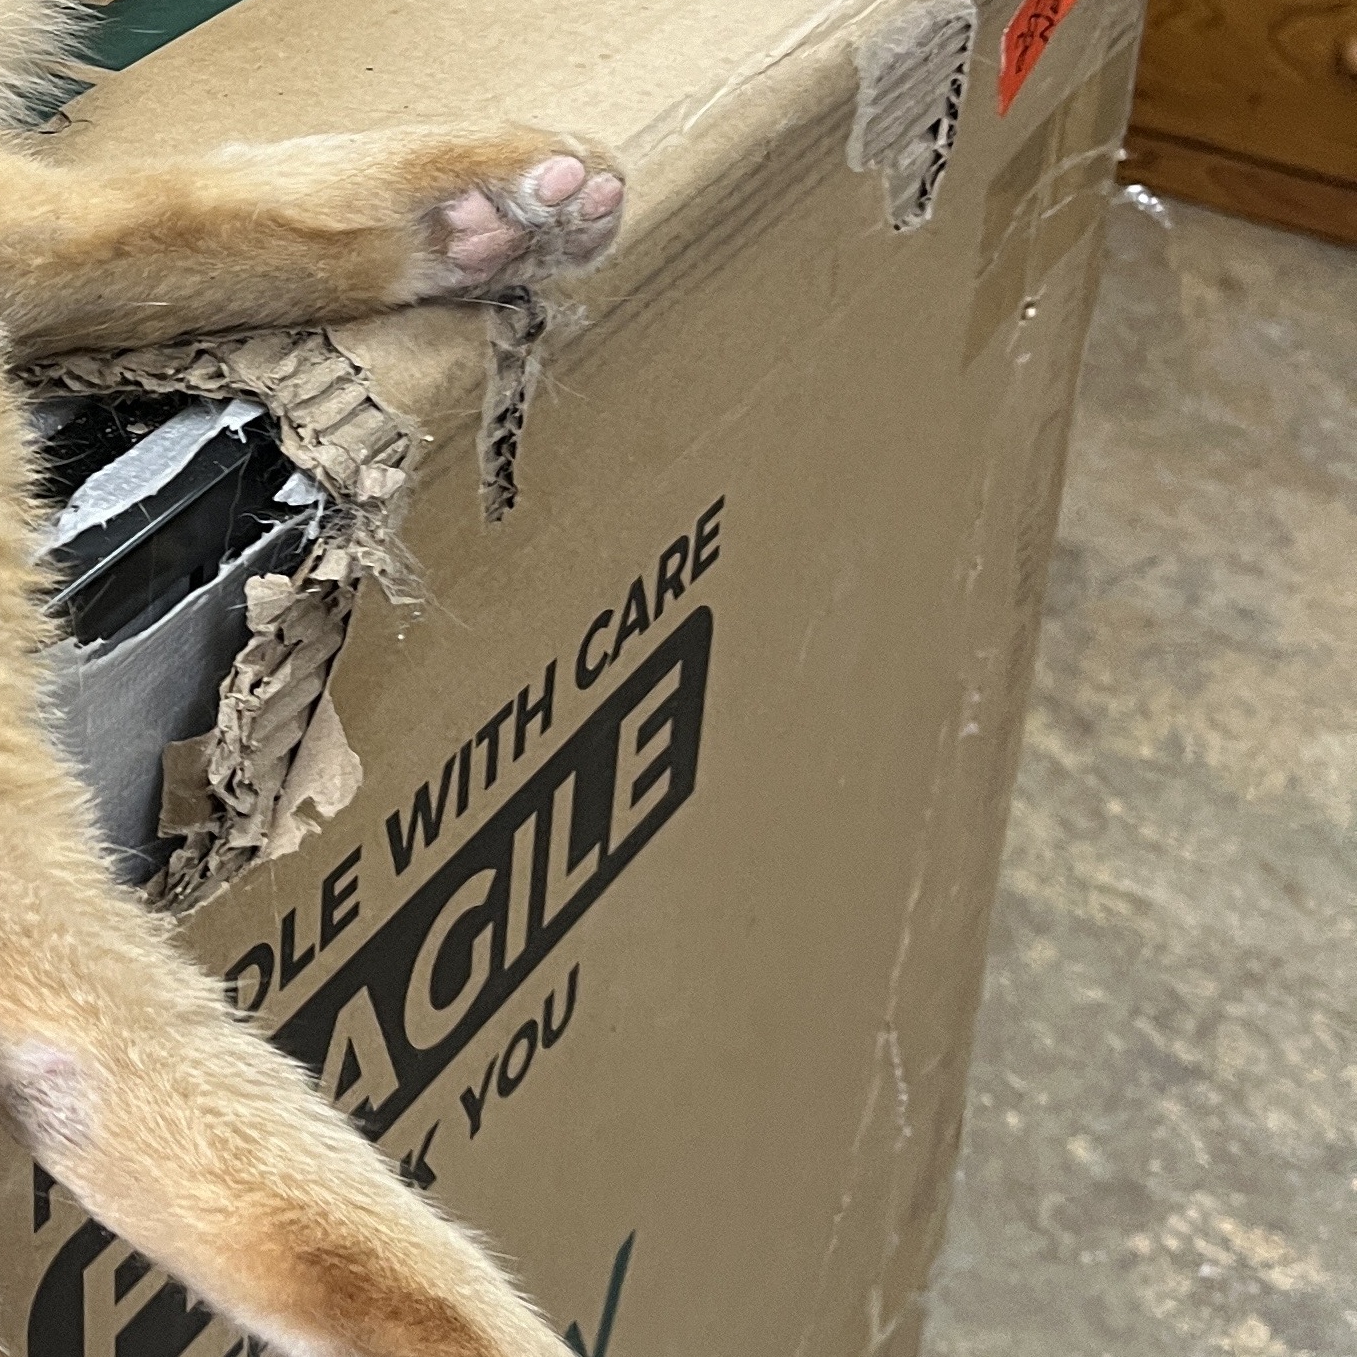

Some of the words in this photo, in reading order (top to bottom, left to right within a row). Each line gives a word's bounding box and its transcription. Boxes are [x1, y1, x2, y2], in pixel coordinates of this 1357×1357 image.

[224, 843, 364, 1020] DLE
[385, 656, 559, 878] WITH
[574, 493, 727, 691] CARE
[319, 658, 684, 1116] AGILE
[459, 961, 580, 1141] YOU
